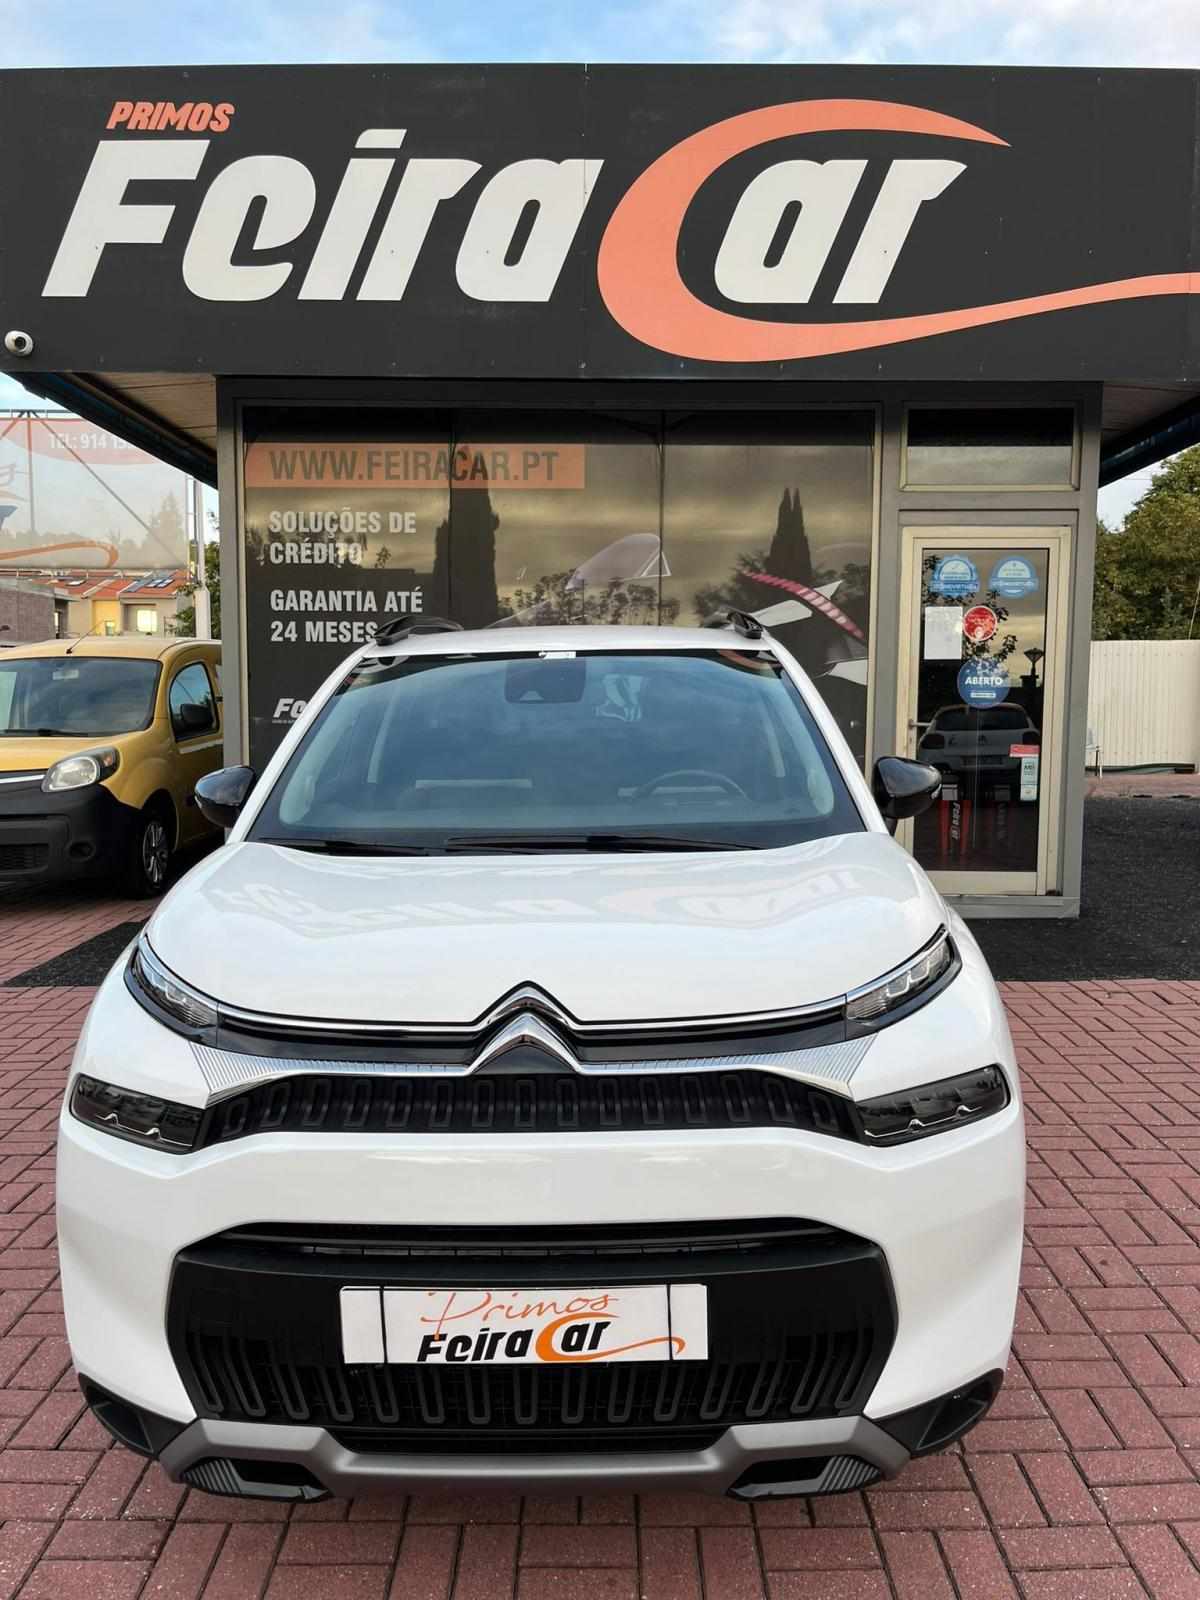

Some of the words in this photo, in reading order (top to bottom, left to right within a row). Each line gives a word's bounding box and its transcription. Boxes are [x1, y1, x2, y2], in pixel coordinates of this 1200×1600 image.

[106, 101, 235, 132] PRIMOS
[80, 432, 107, 449] 914
[270, 450, 559, 481] WWW.FEIRACAR.PT
[270, 507, 382, 538] SOLUÇÕES
[389, 511, 417, 533] DE
[270, 537, 363, 565] CRÉDITO
[270, 589, 378, 612] GARANTIA
[384, 586, 423, 613] ATÉ
[270, 620, 298, 642] 24
[305, 621, 379, 643] MESES
[965, 676, 1004, 686] ABERTO
[420, 1292, 619, 1341] Primos
